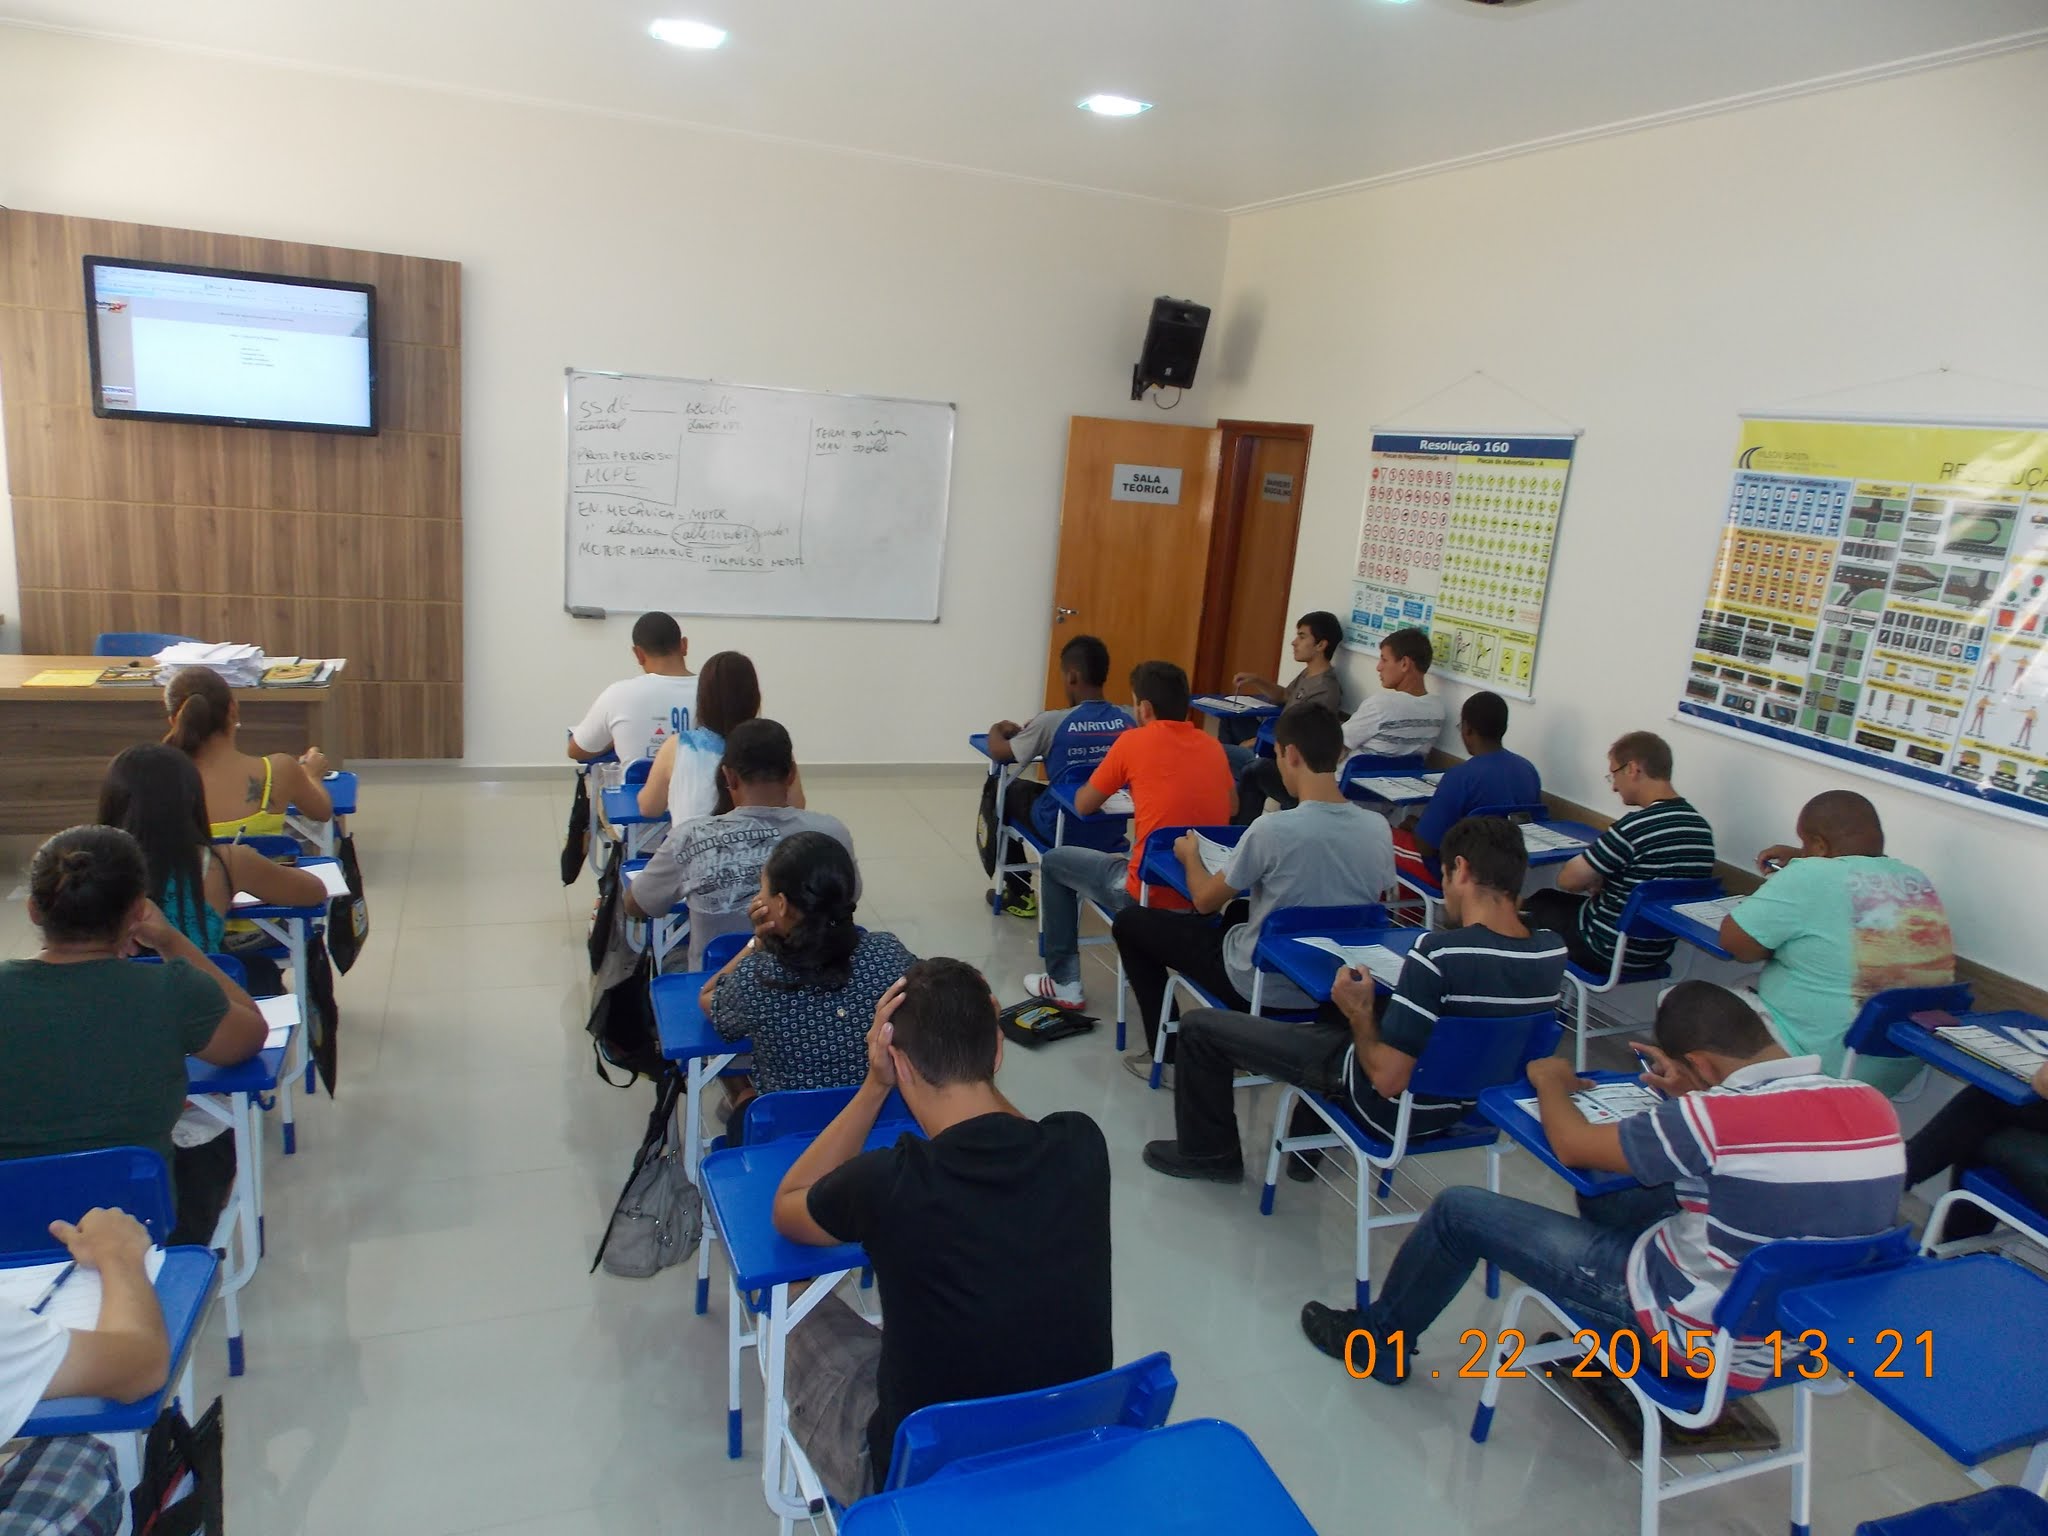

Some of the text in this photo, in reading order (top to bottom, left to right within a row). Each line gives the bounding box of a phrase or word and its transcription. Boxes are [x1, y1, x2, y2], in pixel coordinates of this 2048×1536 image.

[1419, 439, 1510, 453] Resolução 160
[1133, 473, 1161, 484] SALA
[1067, 718, 1124, 733] ANRITUR
[1067, 746, 1087, 757] (35)
[721, 827, 780, 844] CLOTHING
